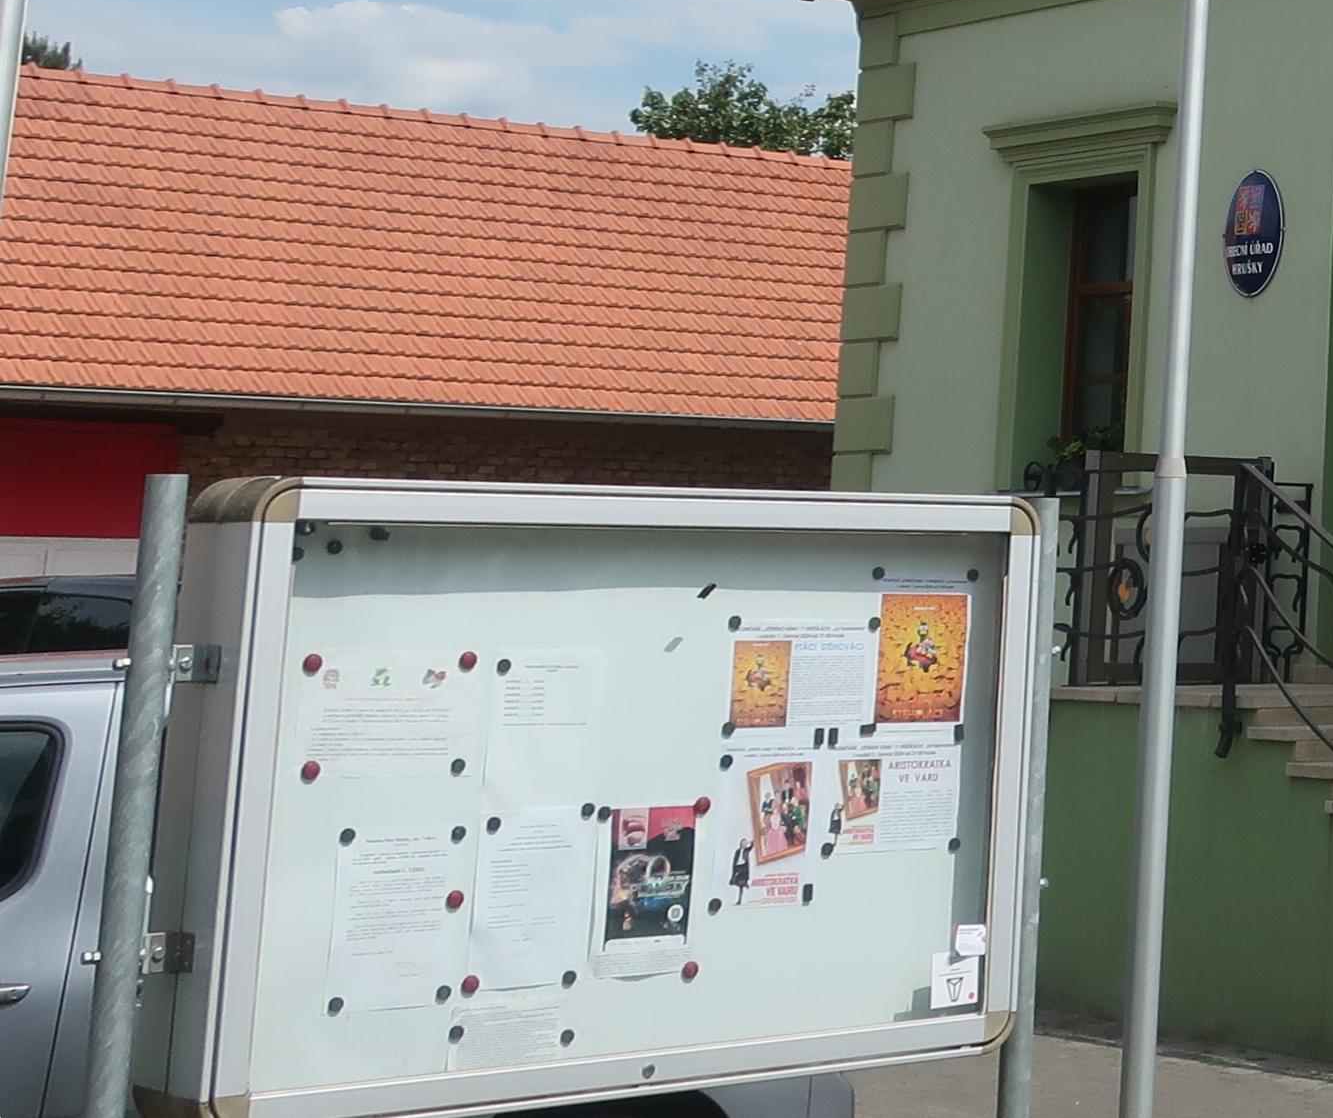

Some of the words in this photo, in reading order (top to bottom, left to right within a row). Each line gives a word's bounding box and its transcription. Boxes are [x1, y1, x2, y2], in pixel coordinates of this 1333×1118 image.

[1249, 240, 1274, 255] ÚŘAD
[1231, 259, 1263, 275] HRUŠKY
[888, 759, 951, 770] ARISTOKRATKA
[898, 774, 910, 783] VE
[915, 773, 938, 782] VARU
